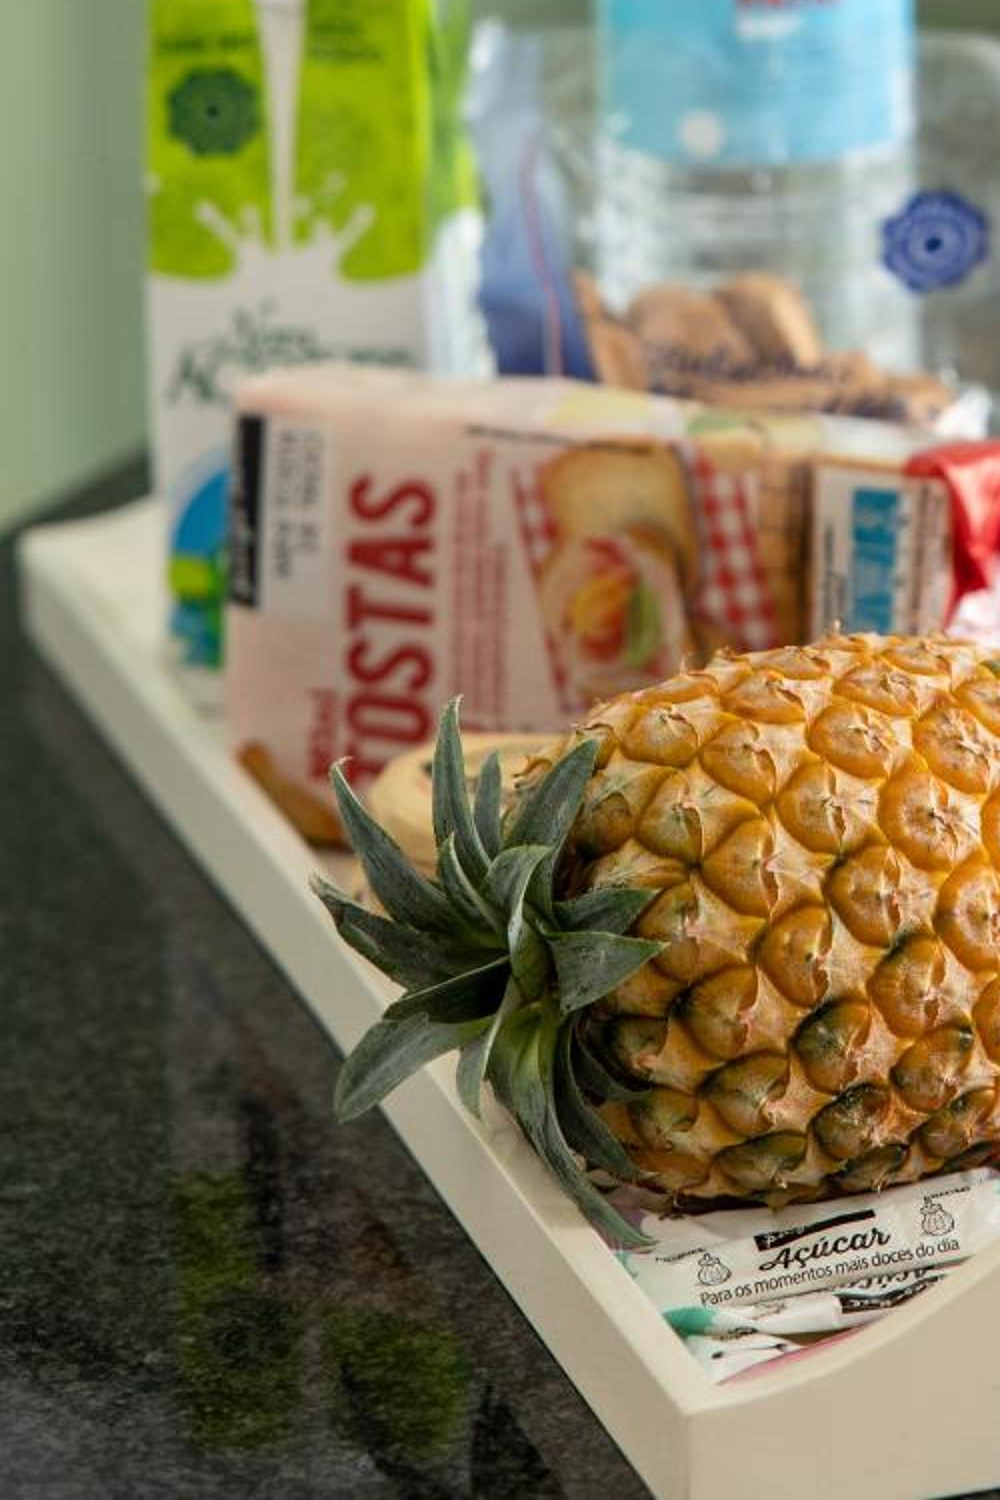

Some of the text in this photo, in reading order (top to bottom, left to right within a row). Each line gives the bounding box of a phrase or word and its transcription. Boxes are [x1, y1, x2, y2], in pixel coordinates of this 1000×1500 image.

[346, 474, 436, 784] TOSTAS
[701, 1288, 733, 1307] Para
[735, 1283, 752, 1298] os
[754, 1263, 832, 1293] momentos
[835, 1255, 868, 1275] mais
[871, 1249, 914, 1267] doces
[915, 1242, 934, 1258] do
[937, 1238, 960, 1253] dia
[758, 1227, 890, 1271] Açúcar
